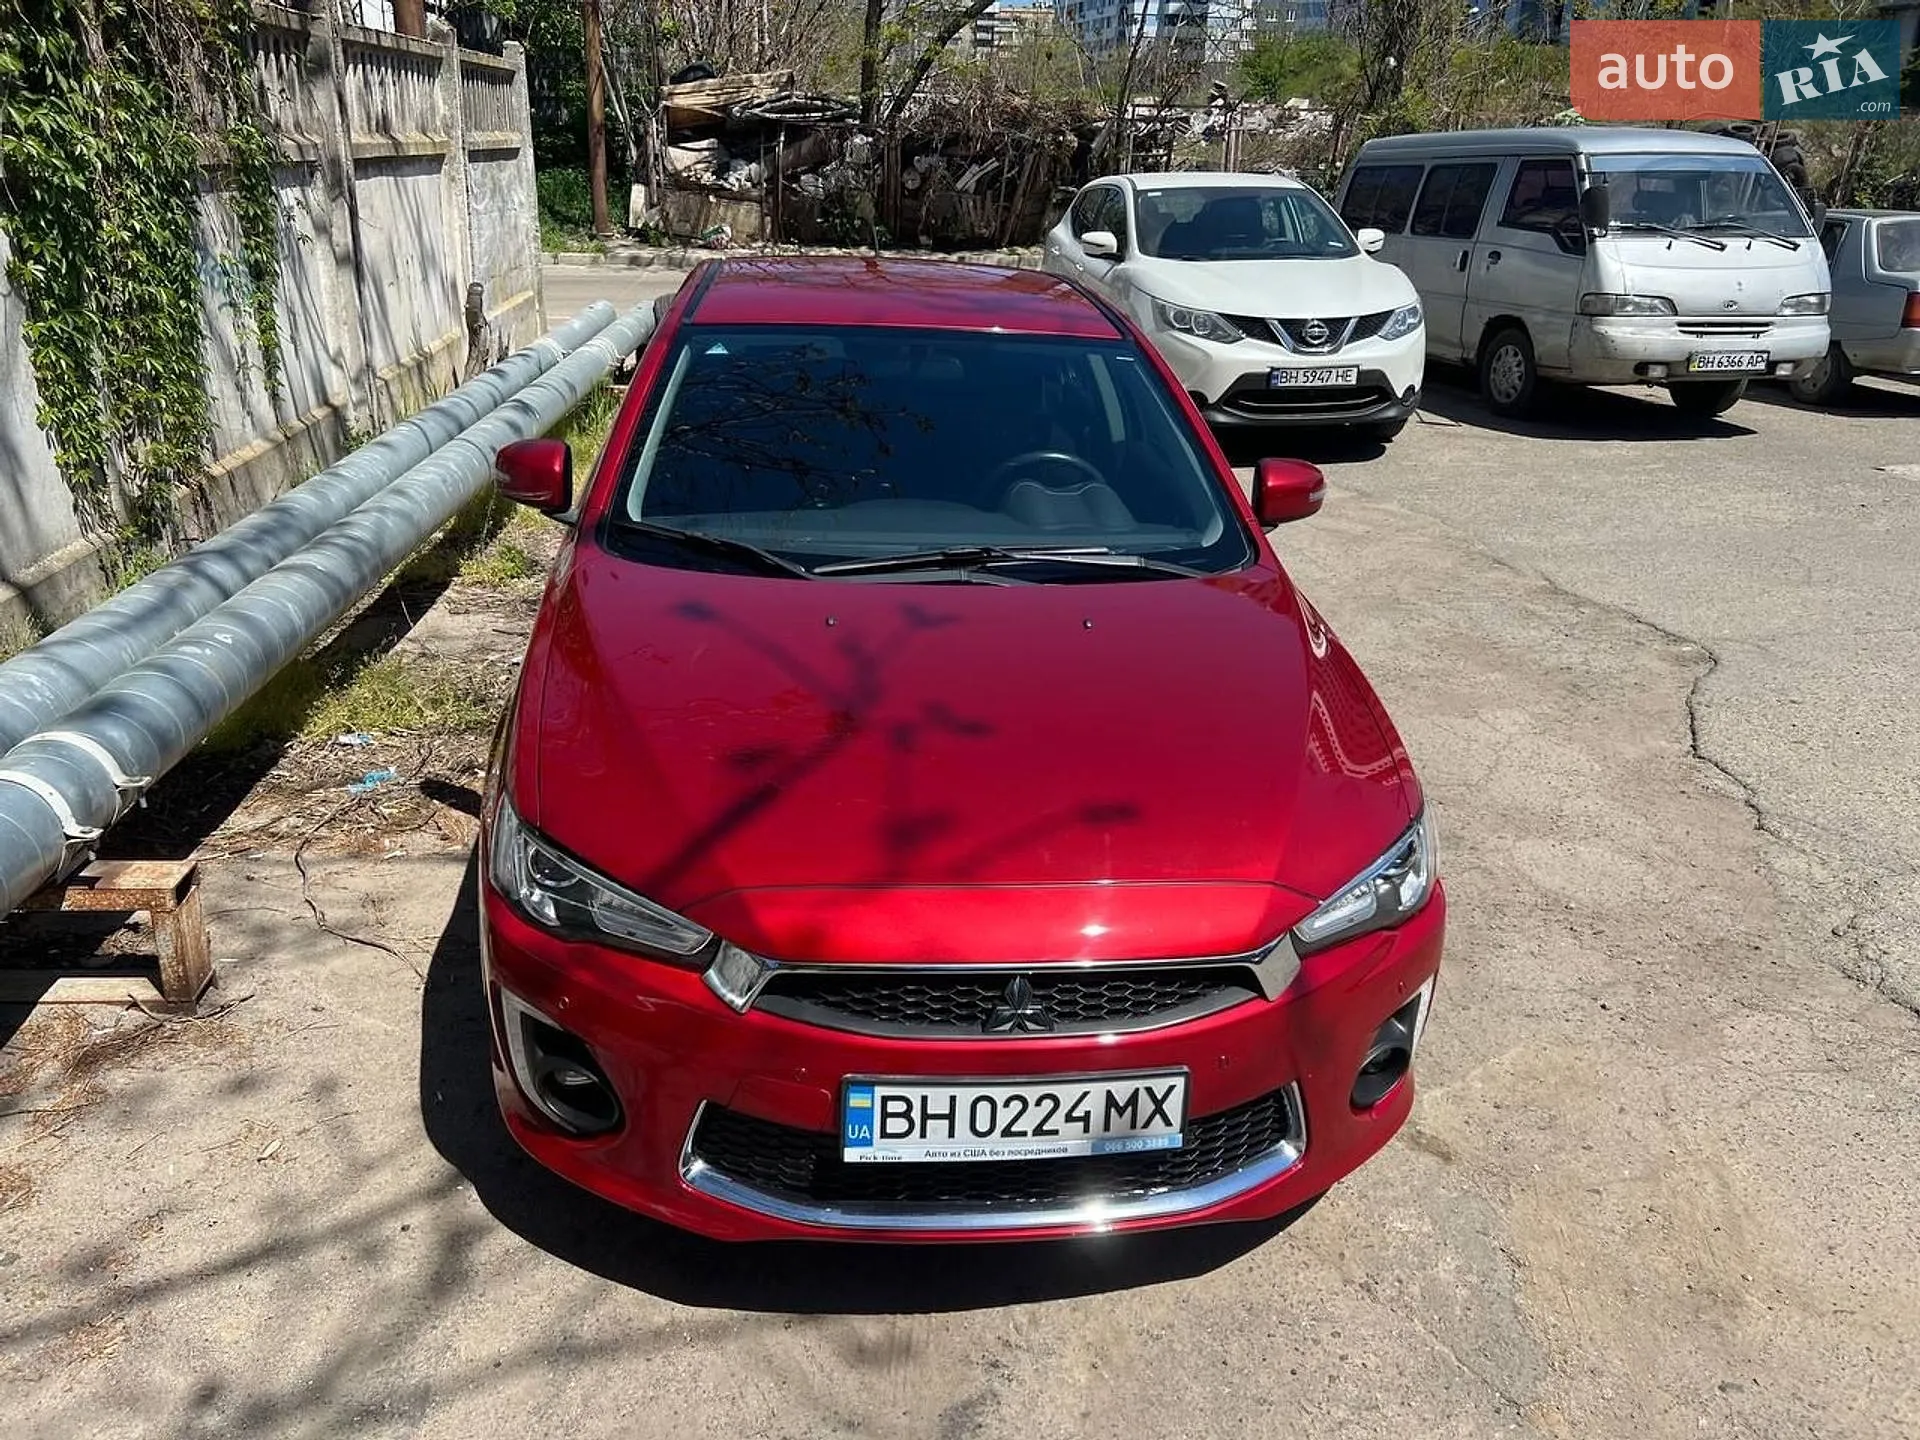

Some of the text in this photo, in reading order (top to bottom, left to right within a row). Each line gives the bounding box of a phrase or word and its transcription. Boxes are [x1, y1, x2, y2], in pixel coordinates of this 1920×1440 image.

[1697, 355, 1765, 369] BH 6366 AP
[1279, 369, 1353, 384] BH 5947 HE
[879, 1084, 1177, 1140] BH 0224 MX
[848, 1125, 870, 1140] UA
[924, 1150, 948, 1158] Авто
[963, 1148, 988, 1158] США
[989, 1148, 1006, 1157] без
[1007, 1145, 1069, 1158] посредников
